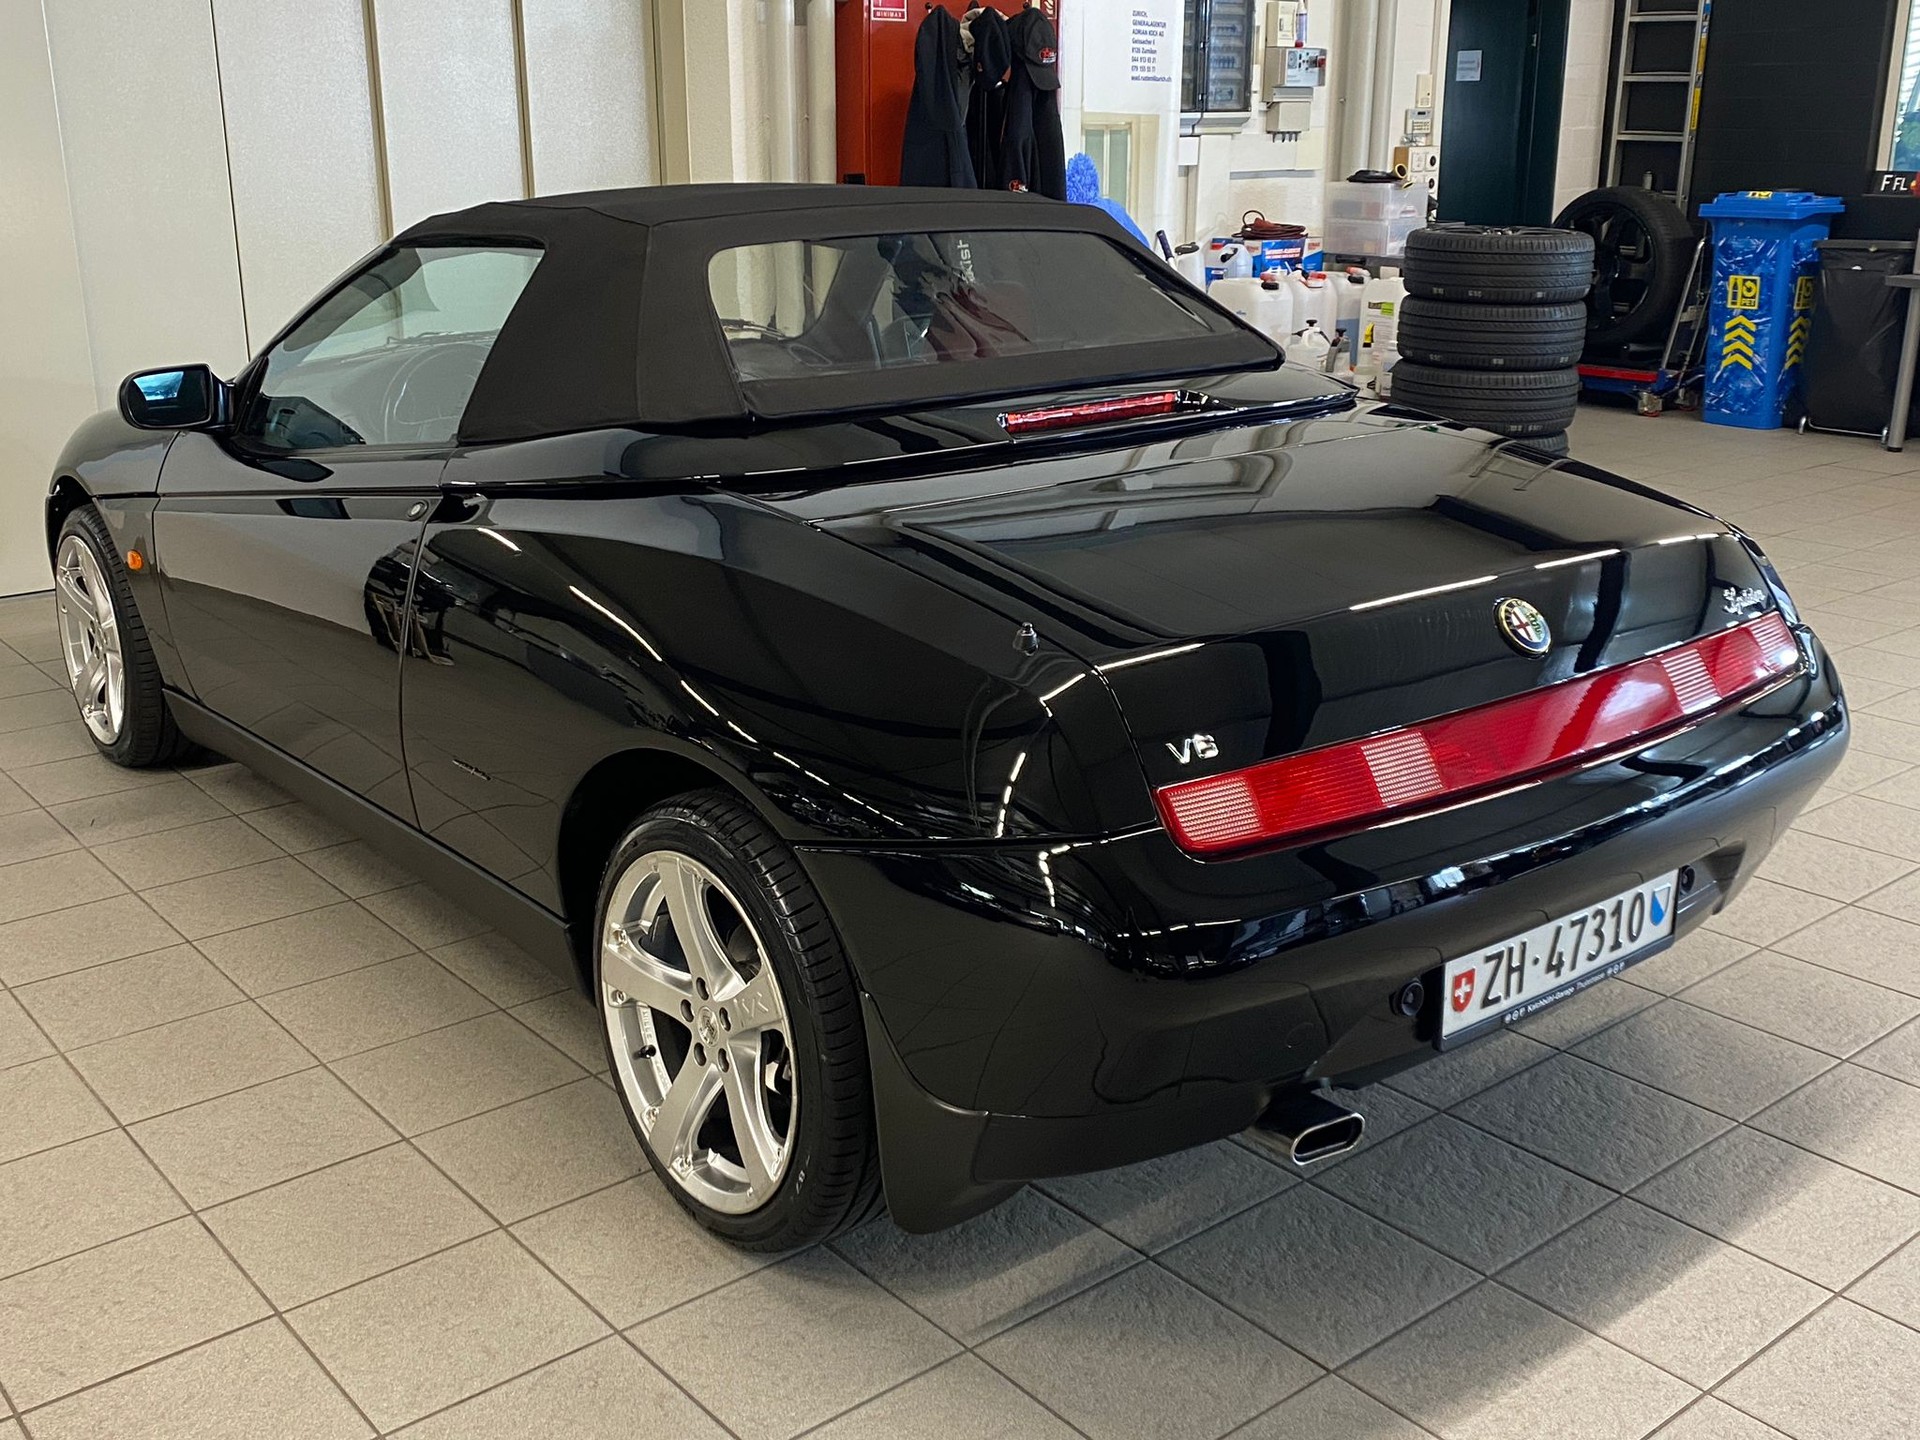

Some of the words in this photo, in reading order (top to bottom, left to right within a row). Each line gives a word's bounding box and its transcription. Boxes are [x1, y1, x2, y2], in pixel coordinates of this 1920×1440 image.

[1132, 19, 1167, 28] GENERALAGENTUR
[1881, 174, 1894, 191] F
[1165, 733, 1219, 764] V6
